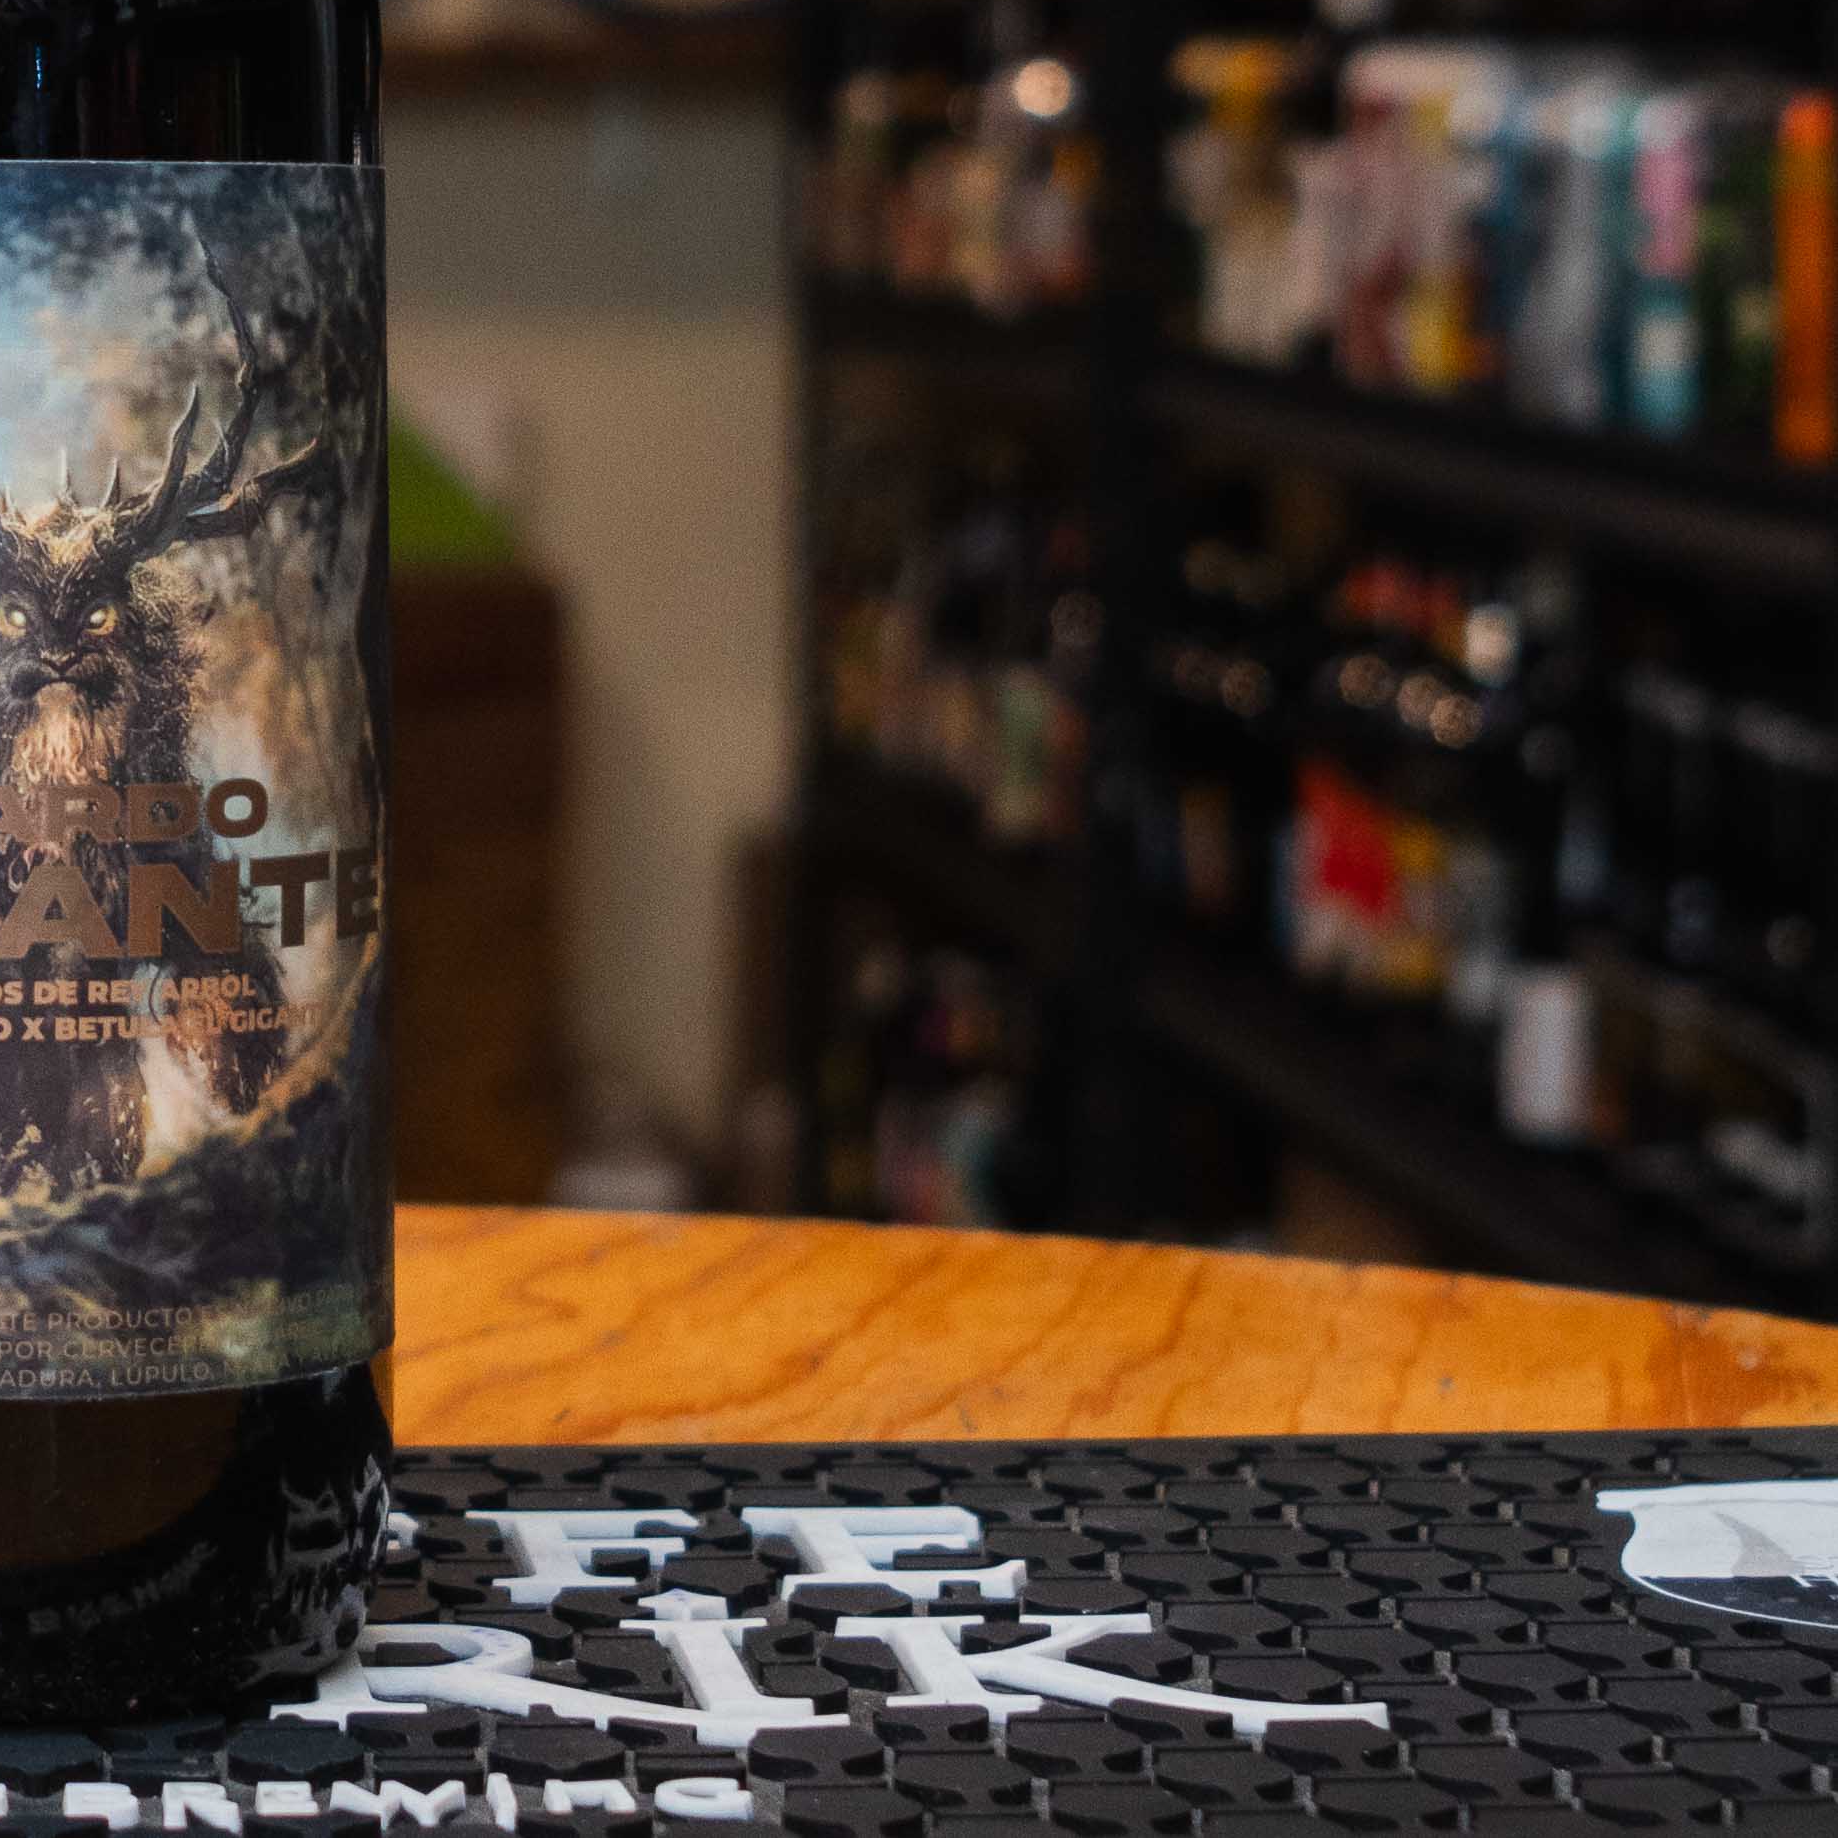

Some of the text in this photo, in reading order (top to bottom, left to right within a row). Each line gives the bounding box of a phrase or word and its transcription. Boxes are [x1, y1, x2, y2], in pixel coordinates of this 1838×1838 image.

[33, 980, 78, 1006] DE
[21, 1017, 44, 1041] X
[48, 1307, 192, 1331] PRODUCTO
